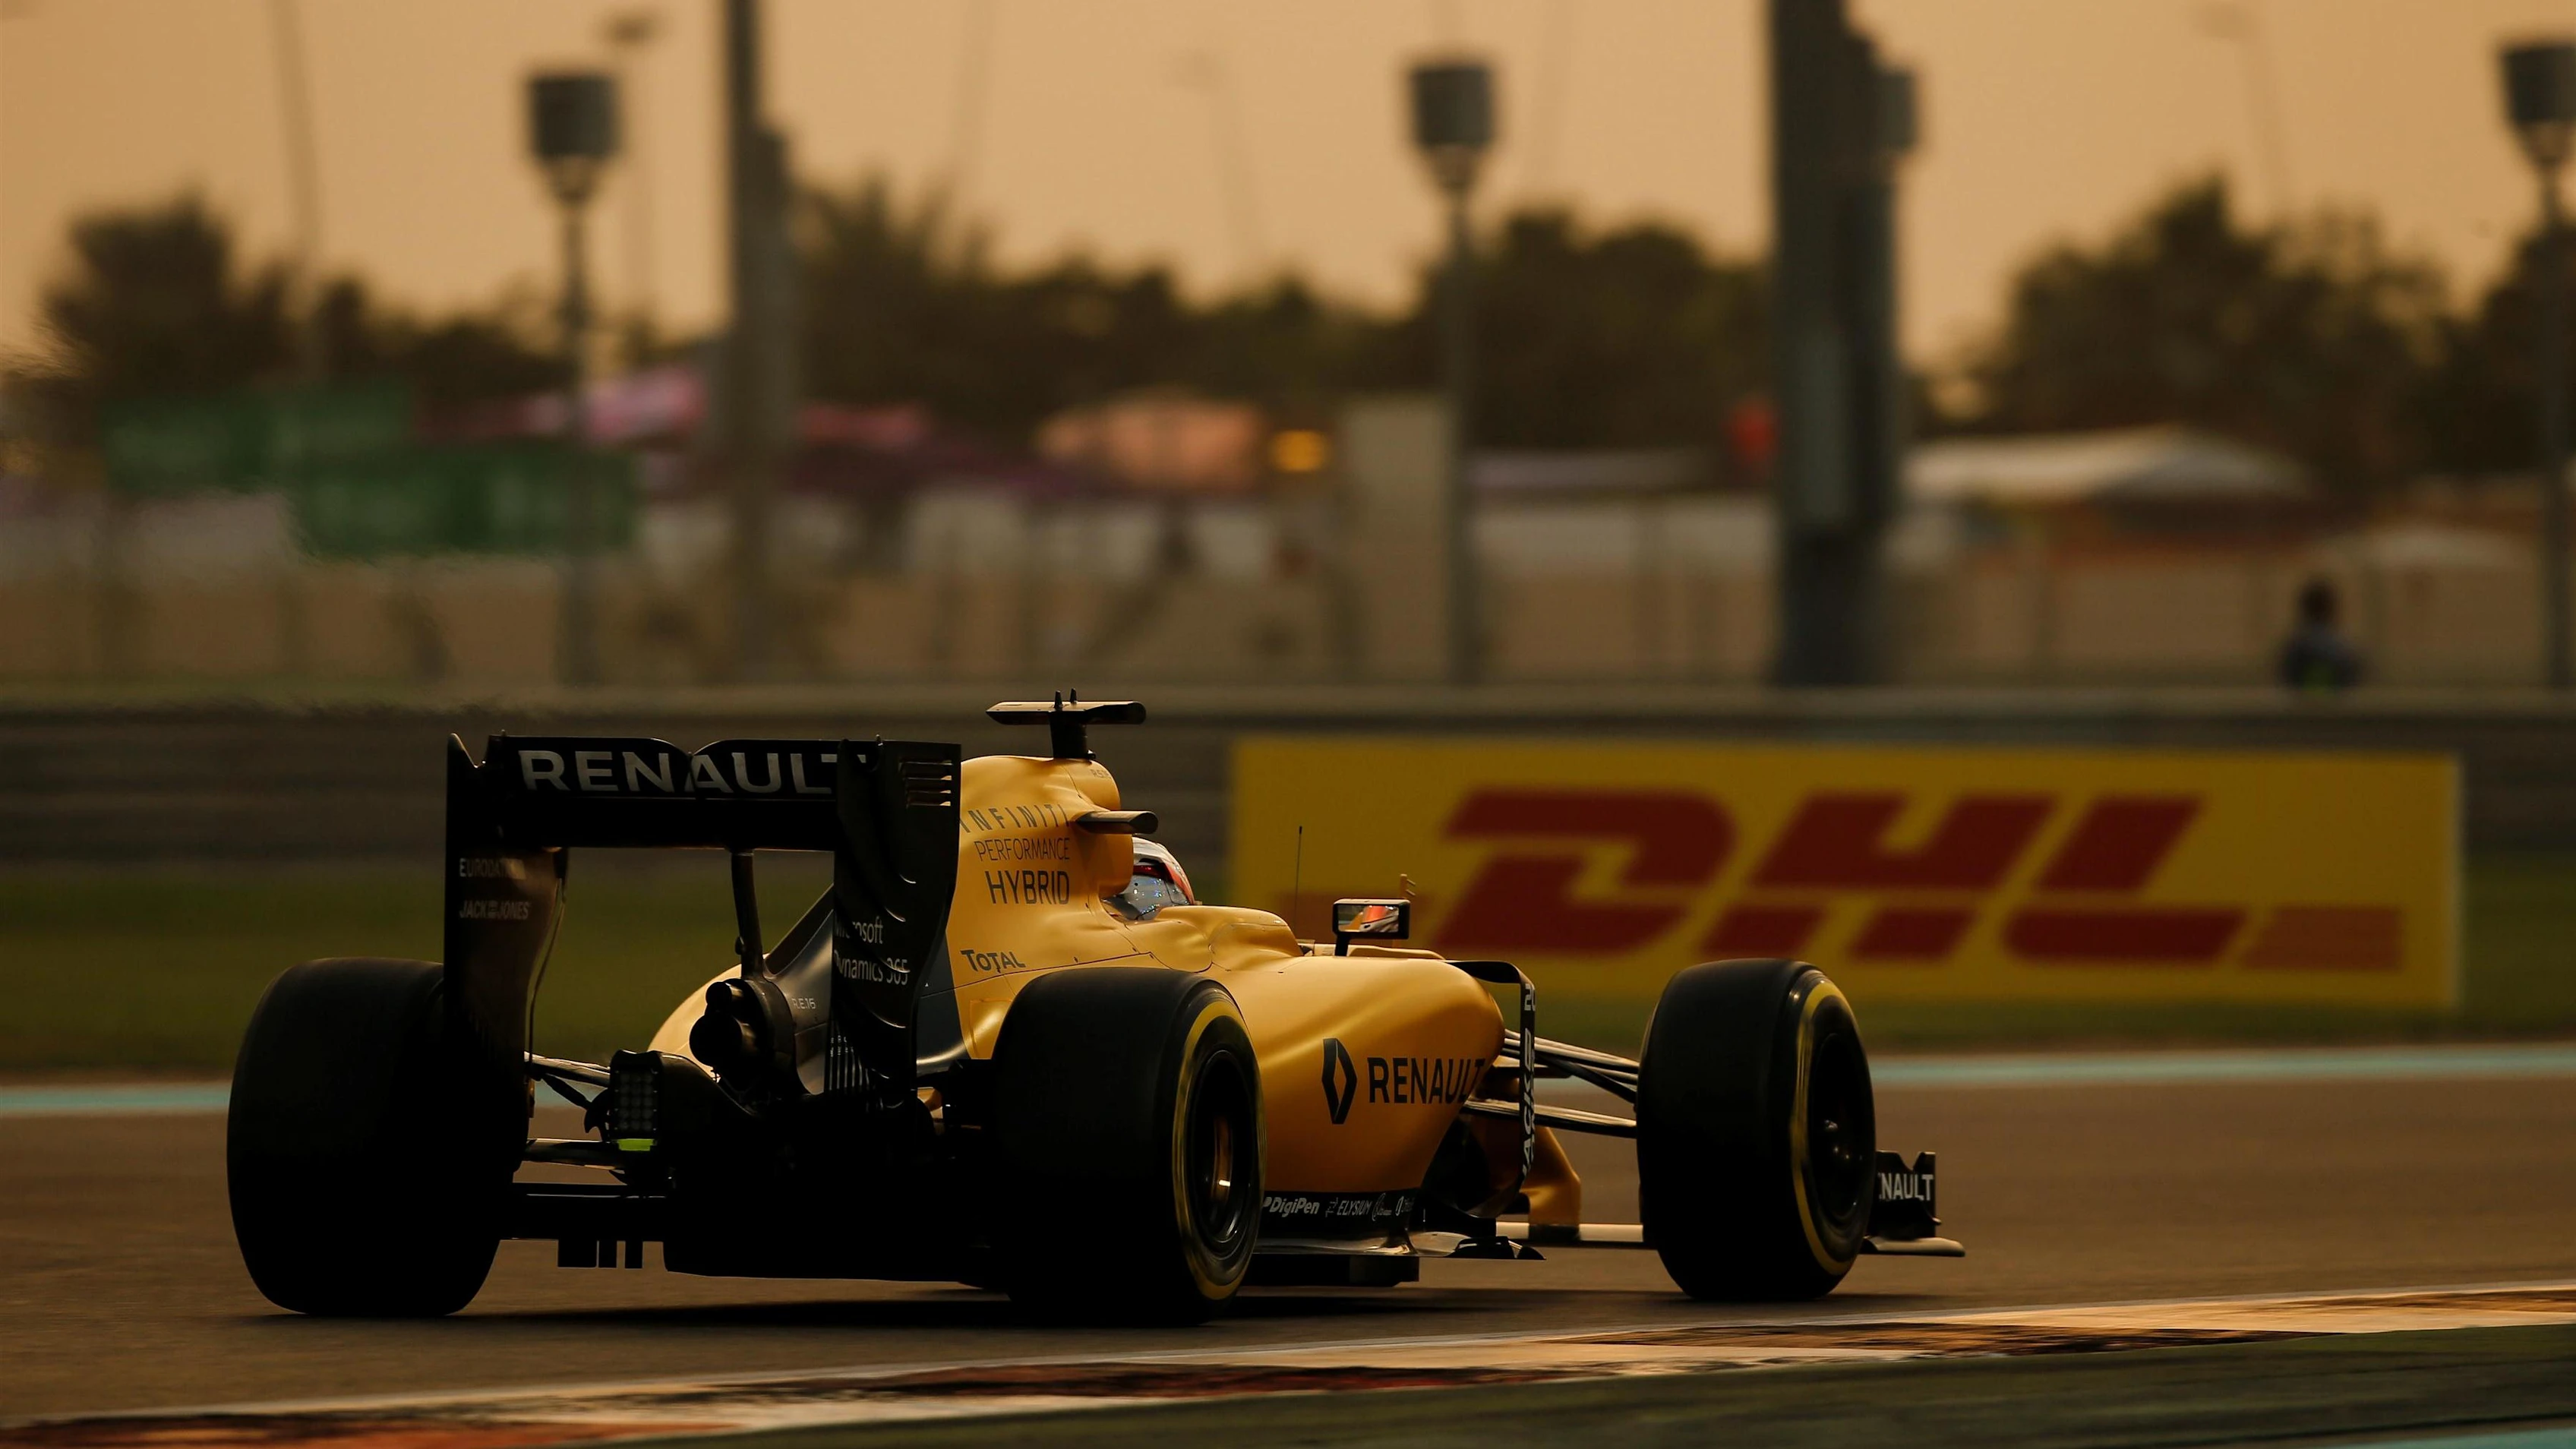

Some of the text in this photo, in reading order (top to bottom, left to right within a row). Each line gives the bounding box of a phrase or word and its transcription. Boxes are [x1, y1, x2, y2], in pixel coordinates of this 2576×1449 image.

[959, 804, 1069, 832] INFINITI
[974, 838, 1070, 861] PERFORMANCE
[985, 870, 1069, 904] HYBRID
[1435, 788, 2246, 964] DHL
[1367, 1057, 1486, 1103] RENAULT
[1877, 1172, 1934, 1201] NAULT
[1269, 1197, 1320, 1218] DigiPen
